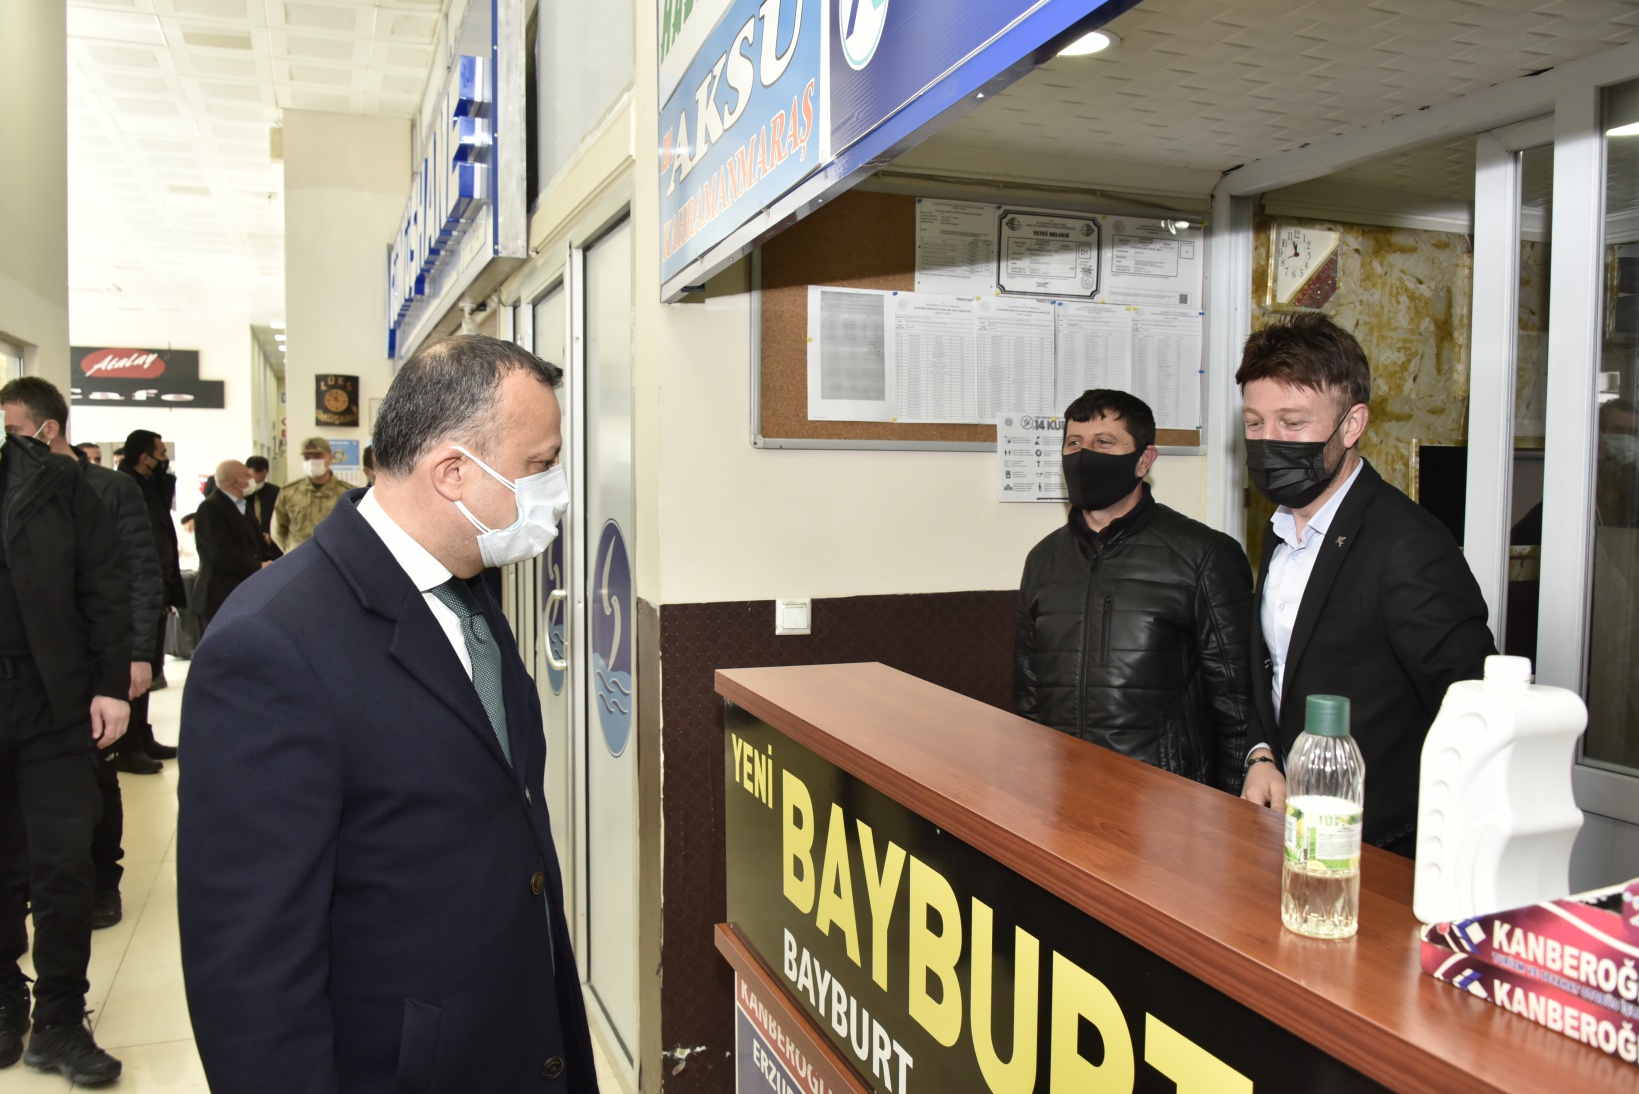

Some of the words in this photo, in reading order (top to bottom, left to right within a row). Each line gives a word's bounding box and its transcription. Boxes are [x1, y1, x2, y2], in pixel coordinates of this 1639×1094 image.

[667, 0, 804, 197] AKSU
[662, 78, 815, 263] KAHRAMANMARAŞ
[85, 353, 158, 377] Atalay
[1034, 419, 1045, 430] 14
[731, 732, 773, 810] YENİ
[1492, 919, 1639, 1001] KANBEROĞ
[784, 927, 913, 1094] BAYBURT
[1493, 979, 1639, 1065] KANBEROĞ
[753, 1038, 794, 1094] ERZU
